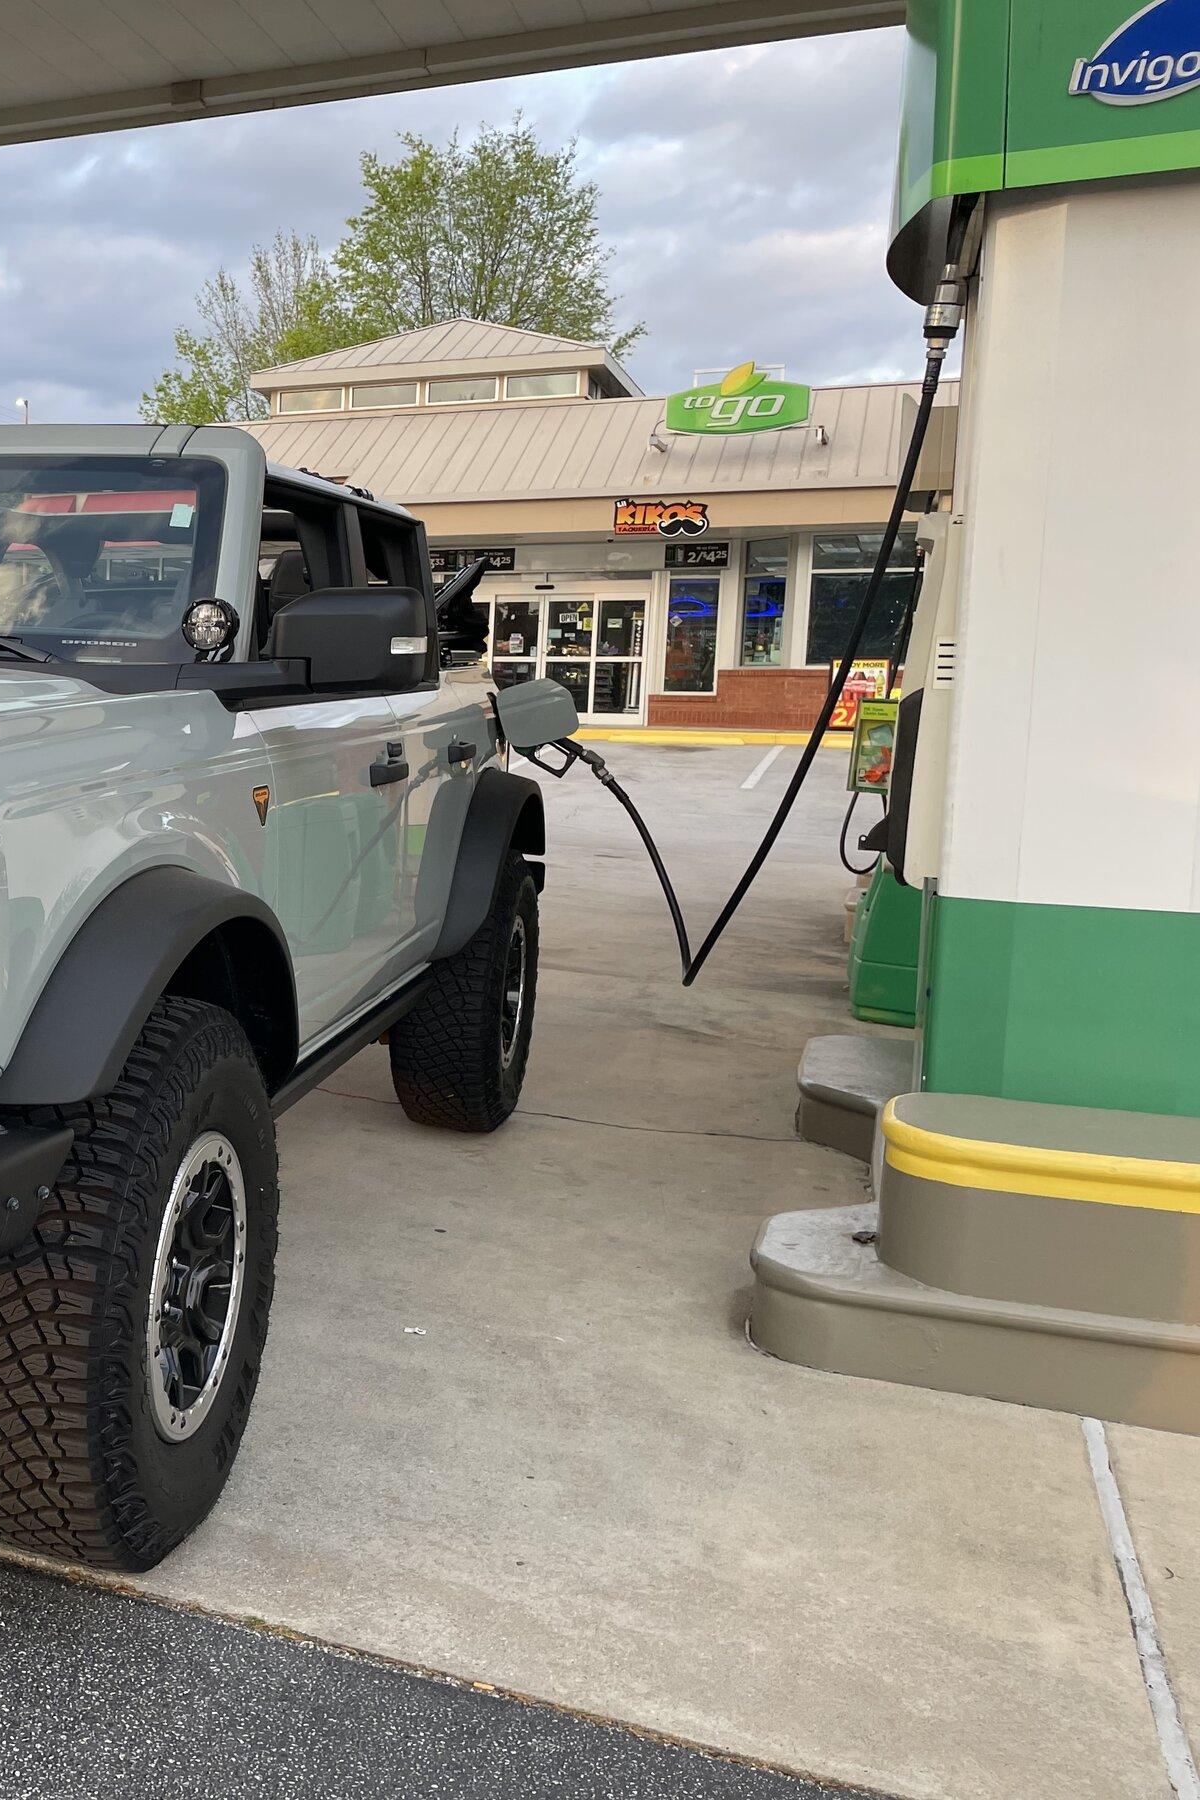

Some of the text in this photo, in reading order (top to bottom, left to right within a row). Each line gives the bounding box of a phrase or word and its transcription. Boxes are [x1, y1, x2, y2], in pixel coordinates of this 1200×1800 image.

[684, 394, 786, 428] to go
[560, 613, 578, 623] OPEN
